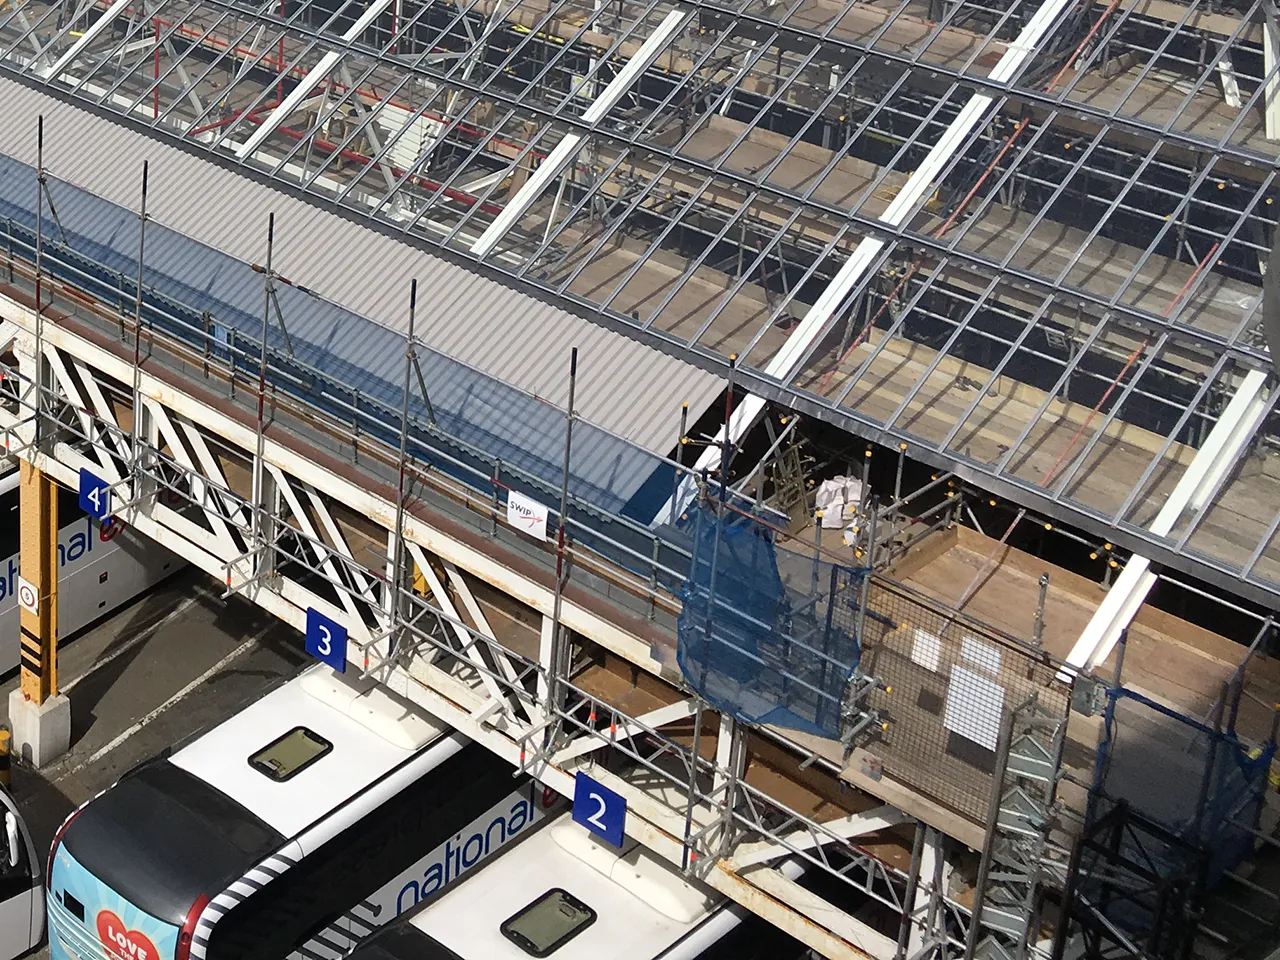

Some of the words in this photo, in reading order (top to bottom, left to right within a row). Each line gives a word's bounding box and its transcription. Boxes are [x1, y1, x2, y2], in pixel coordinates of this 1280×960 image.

[87, 486, 101, 512] 4
[509, 500, 532, 516] SWIP
[317, 624, 332, 656] 3
[586, 792, 607, 831] 2
[396, 779, 536, 917] national
[107, 925, 148, 960] LOVE
